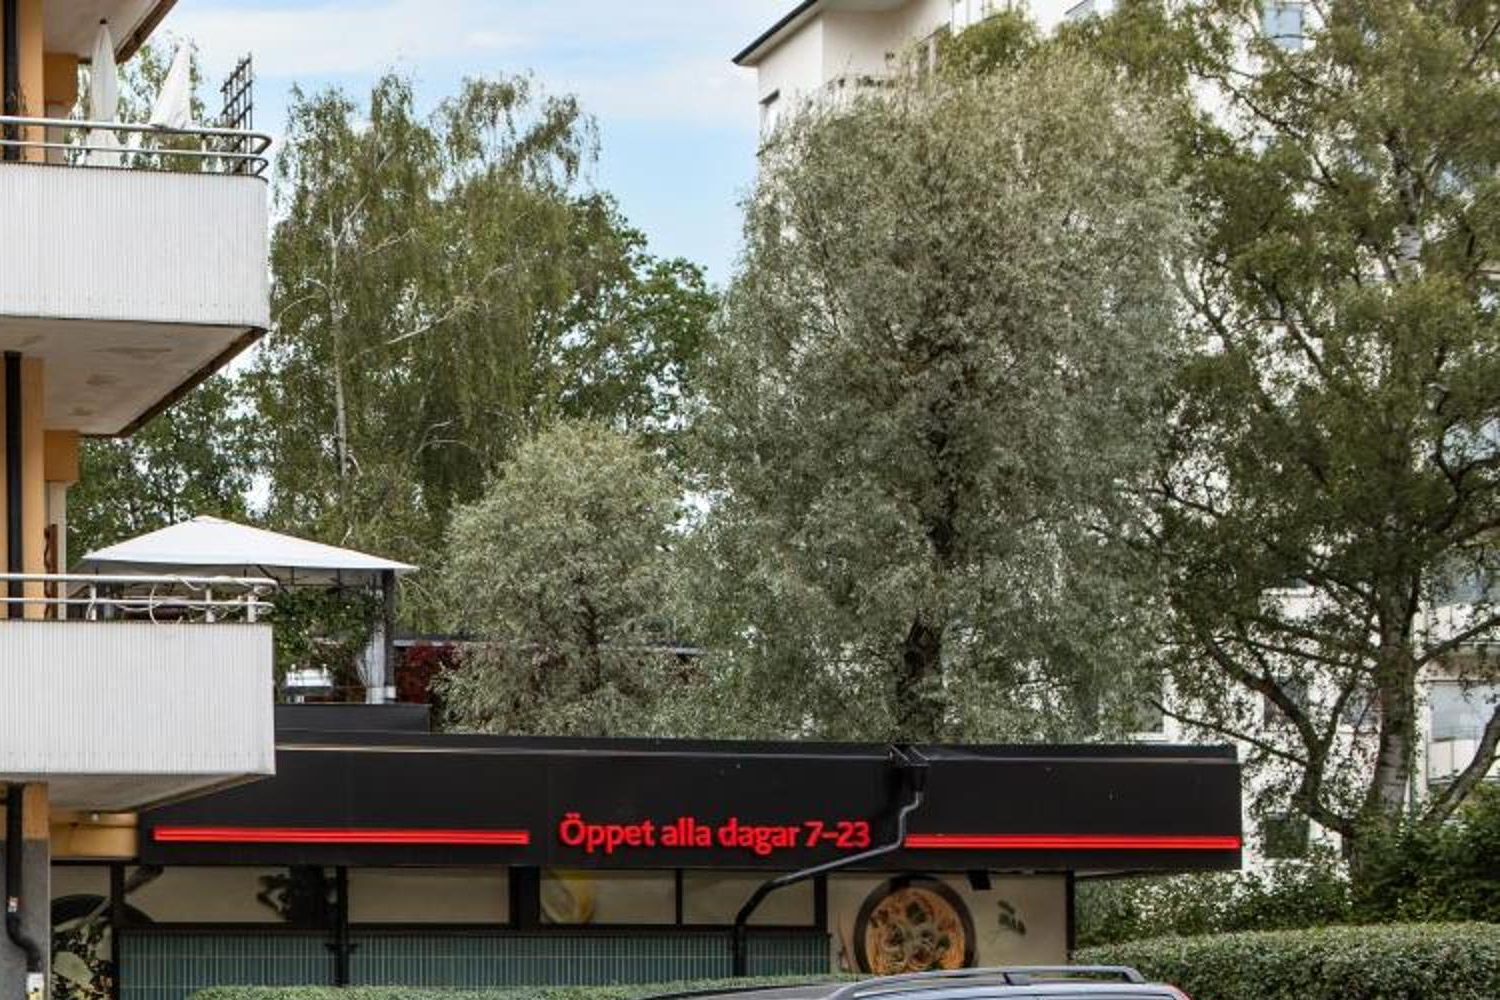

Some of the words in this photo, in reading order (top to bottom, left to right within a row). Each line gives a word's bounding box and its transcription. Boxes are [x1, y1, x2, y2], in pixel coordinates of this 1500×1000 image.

[559, 812, 654, 853] Öppet
[661, 817, 712, 847] alla
[718, 817, 800, 855] dagar
